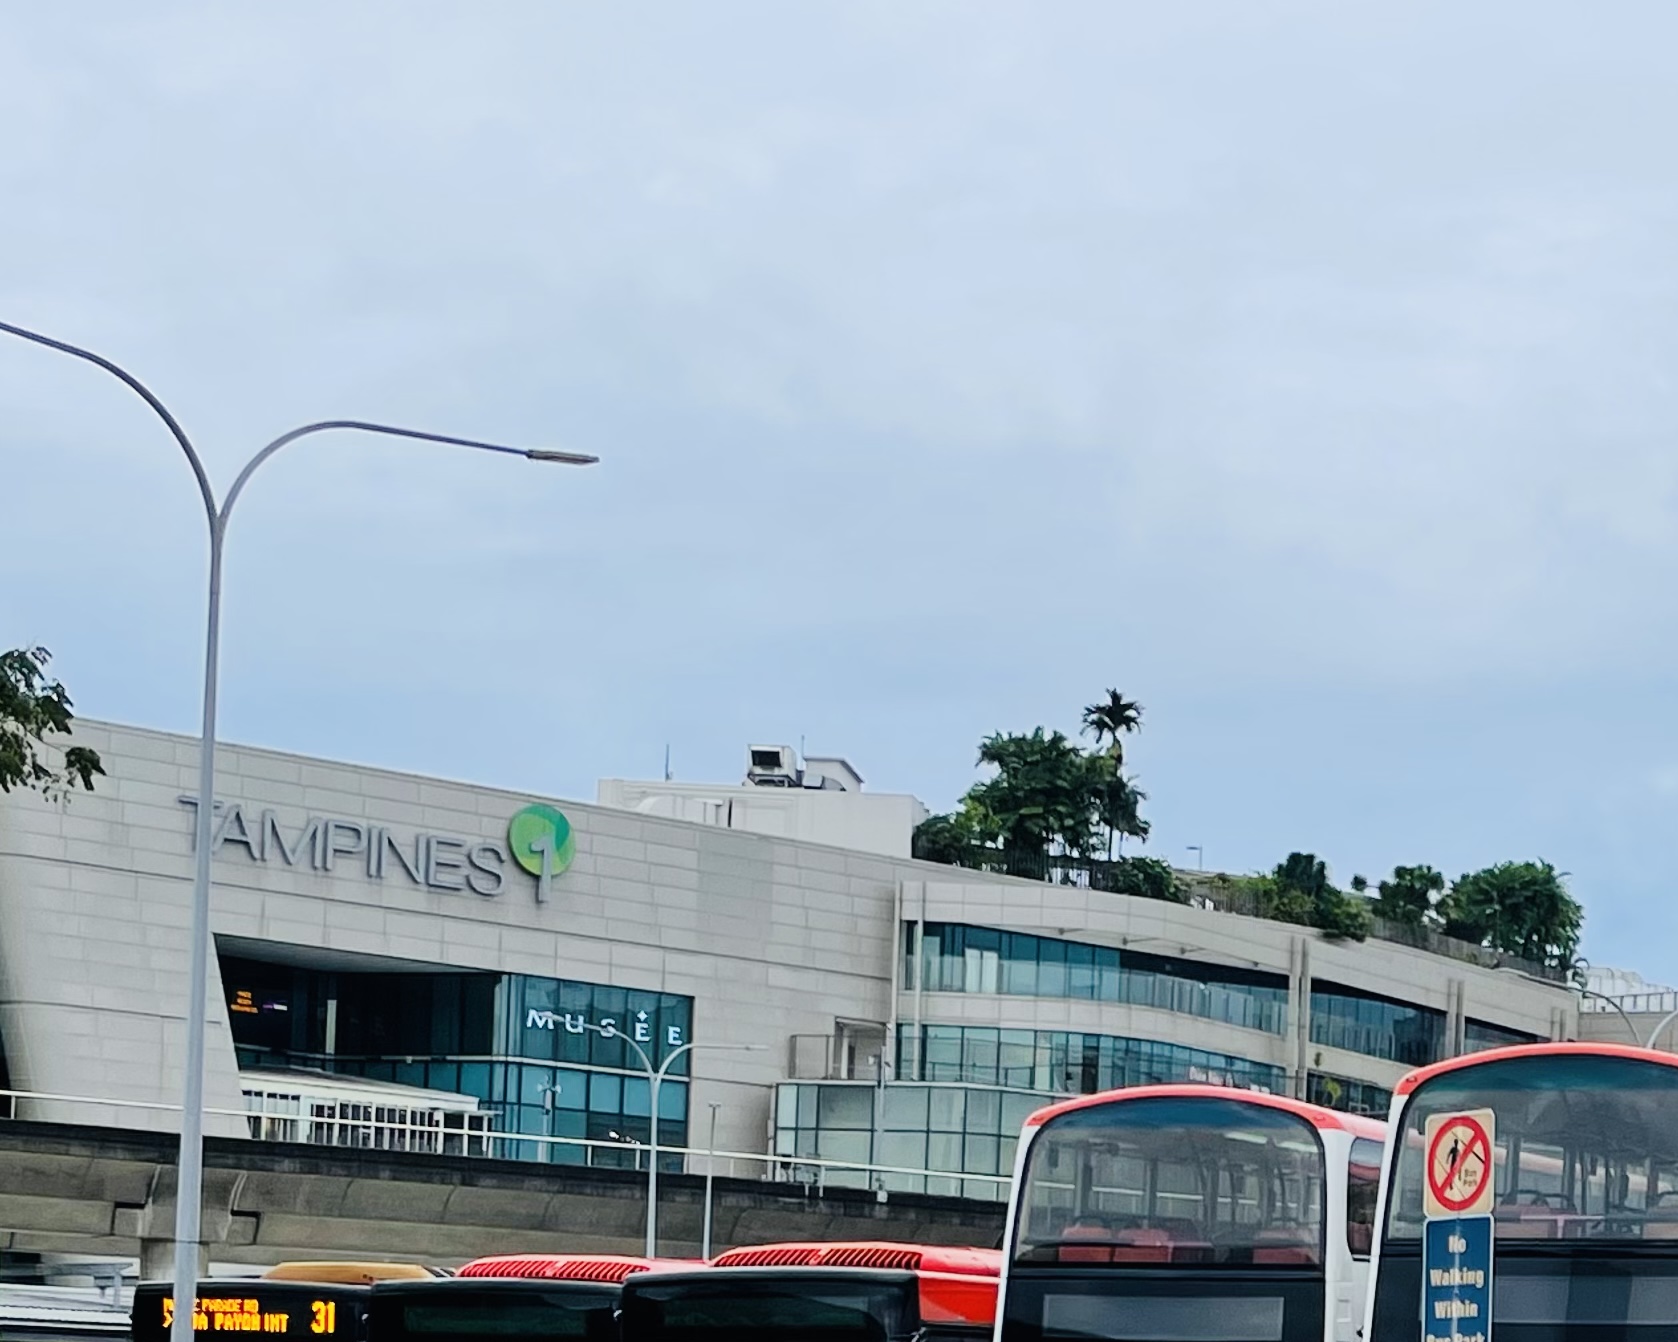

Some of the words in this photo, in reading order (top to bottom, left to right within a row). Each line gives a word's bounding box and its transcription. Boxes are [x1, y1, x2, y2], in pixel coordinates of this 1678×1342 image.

[177, 795, 505, 897] TAMPINES
[530, 831, 554, 903] 1
[1448, 1234, 1467, 1253] No
[1430, 1267, 1484, 1288] Walking
[311, 1301, 336, 1334] 31
[1434, 1299, 1478, 1319] Within
